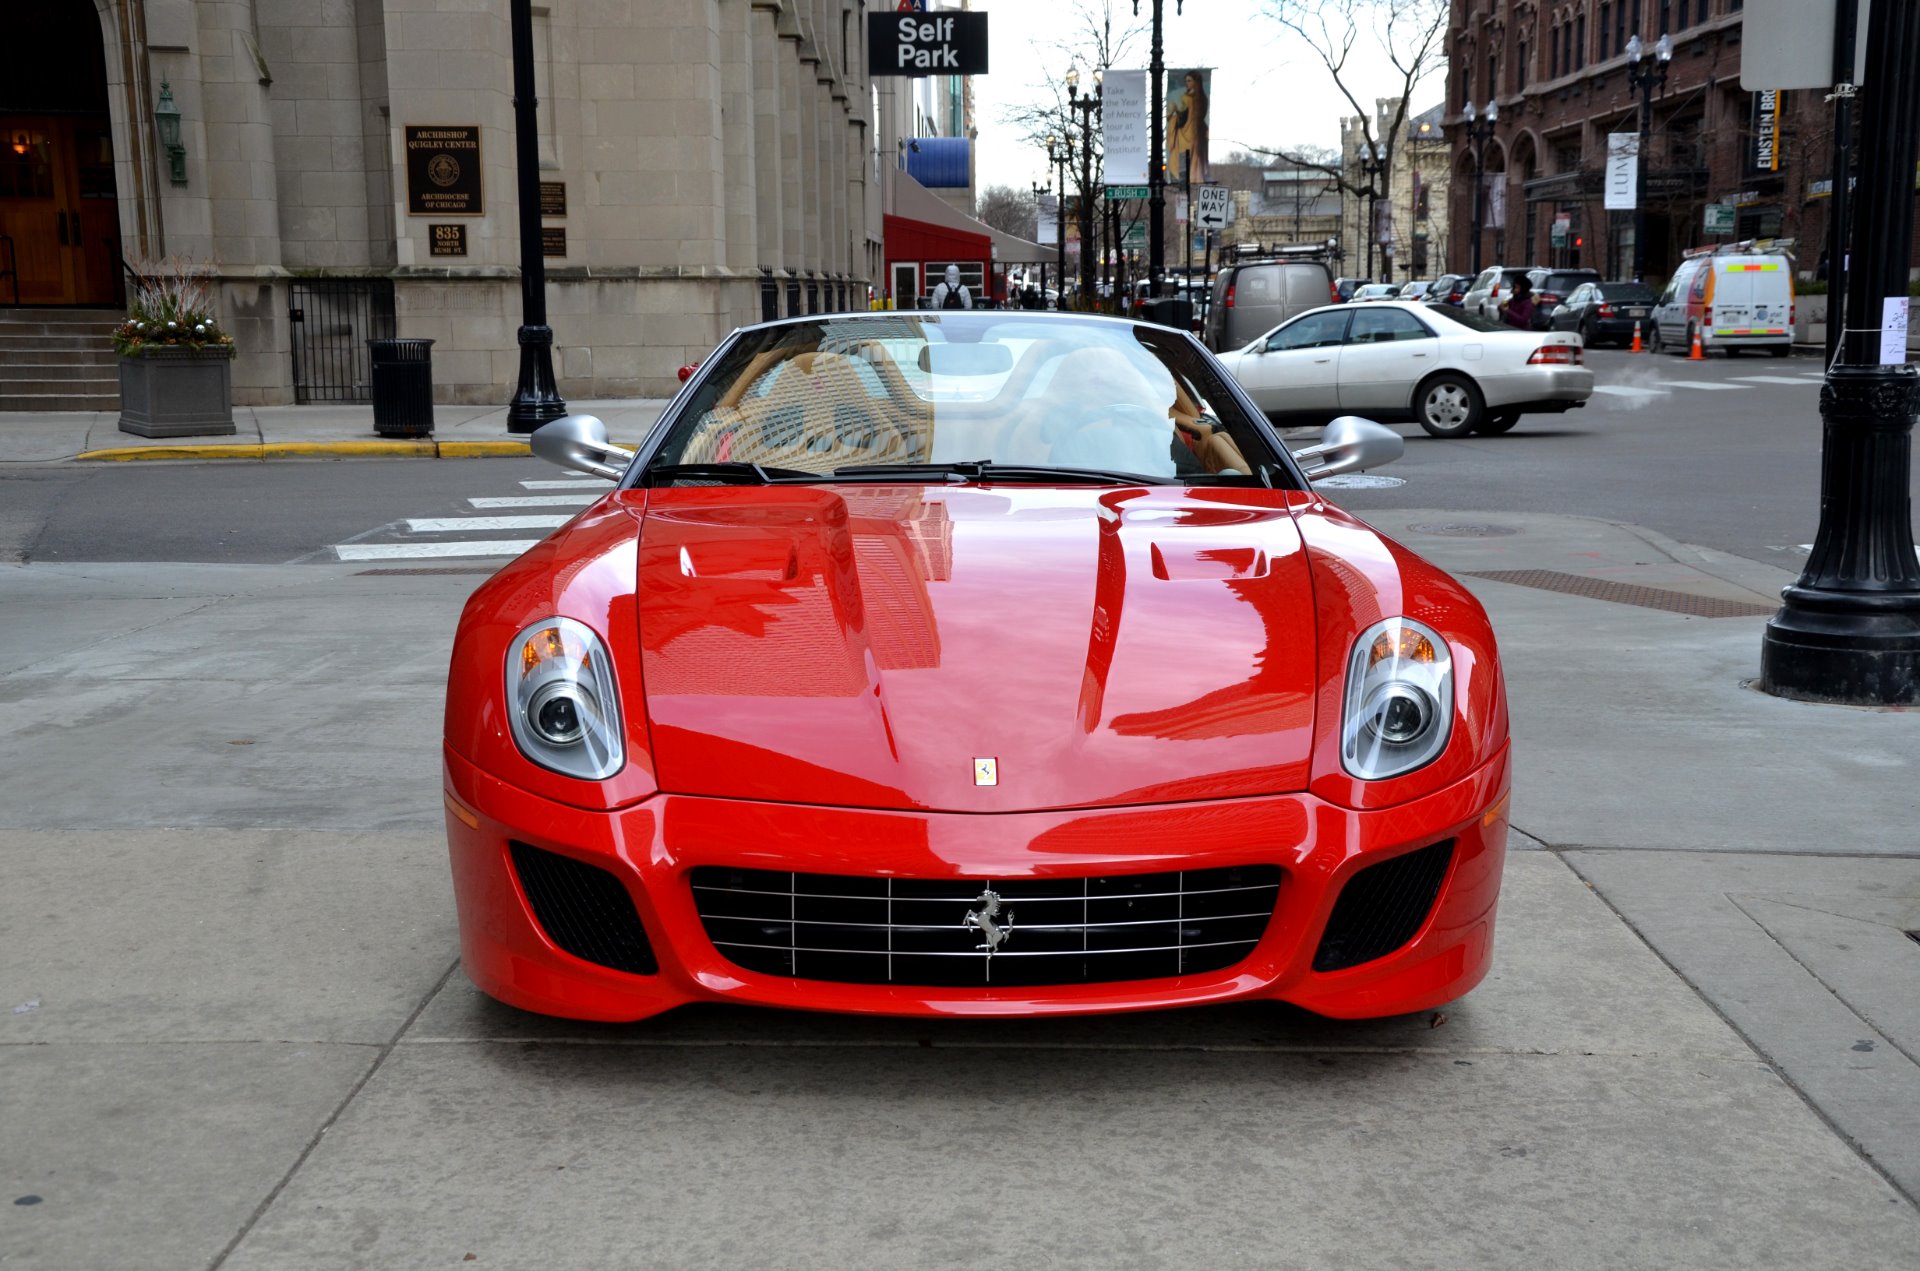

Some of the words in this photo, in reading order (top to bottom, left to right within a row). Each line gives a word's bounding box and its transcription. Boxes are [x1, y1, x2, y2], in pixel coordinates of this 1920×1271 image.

[898, 17, 954, 42] Self
[898, 44, 959, 67] Park
[1106, 86, 1124, 95] Take
[1106, 99, 1118, 107] the
[1121, 98, 1138, 107] Year
[1106, 110, 1115, 119] of
[1116, 110, 1141, 120] Mercy
[1106, 123, 1123, 131] tour
[1125, 122, 1133, 130] at
[416, 131, 468, 139] ARCHBISHOP
[1106, 134, 1120, 142] the
[1122, 134, 1135, 142] Art
[408, 141, 444, 149] QUIGLEY
[445, 141, 477, 149] CENTER
[1757, 113, 1774, 169] EINSTEIN
[1107, 145, 1141, 154] Institute
[421, 193, 470, 201] ARCHDIOCESE
[1114, 188, 1138, 198] RUSH
[1202, 189, 1226, 201] ONE
[1200, 201, 1226, 212] WAY
[435, 226, 460, 240] 835
